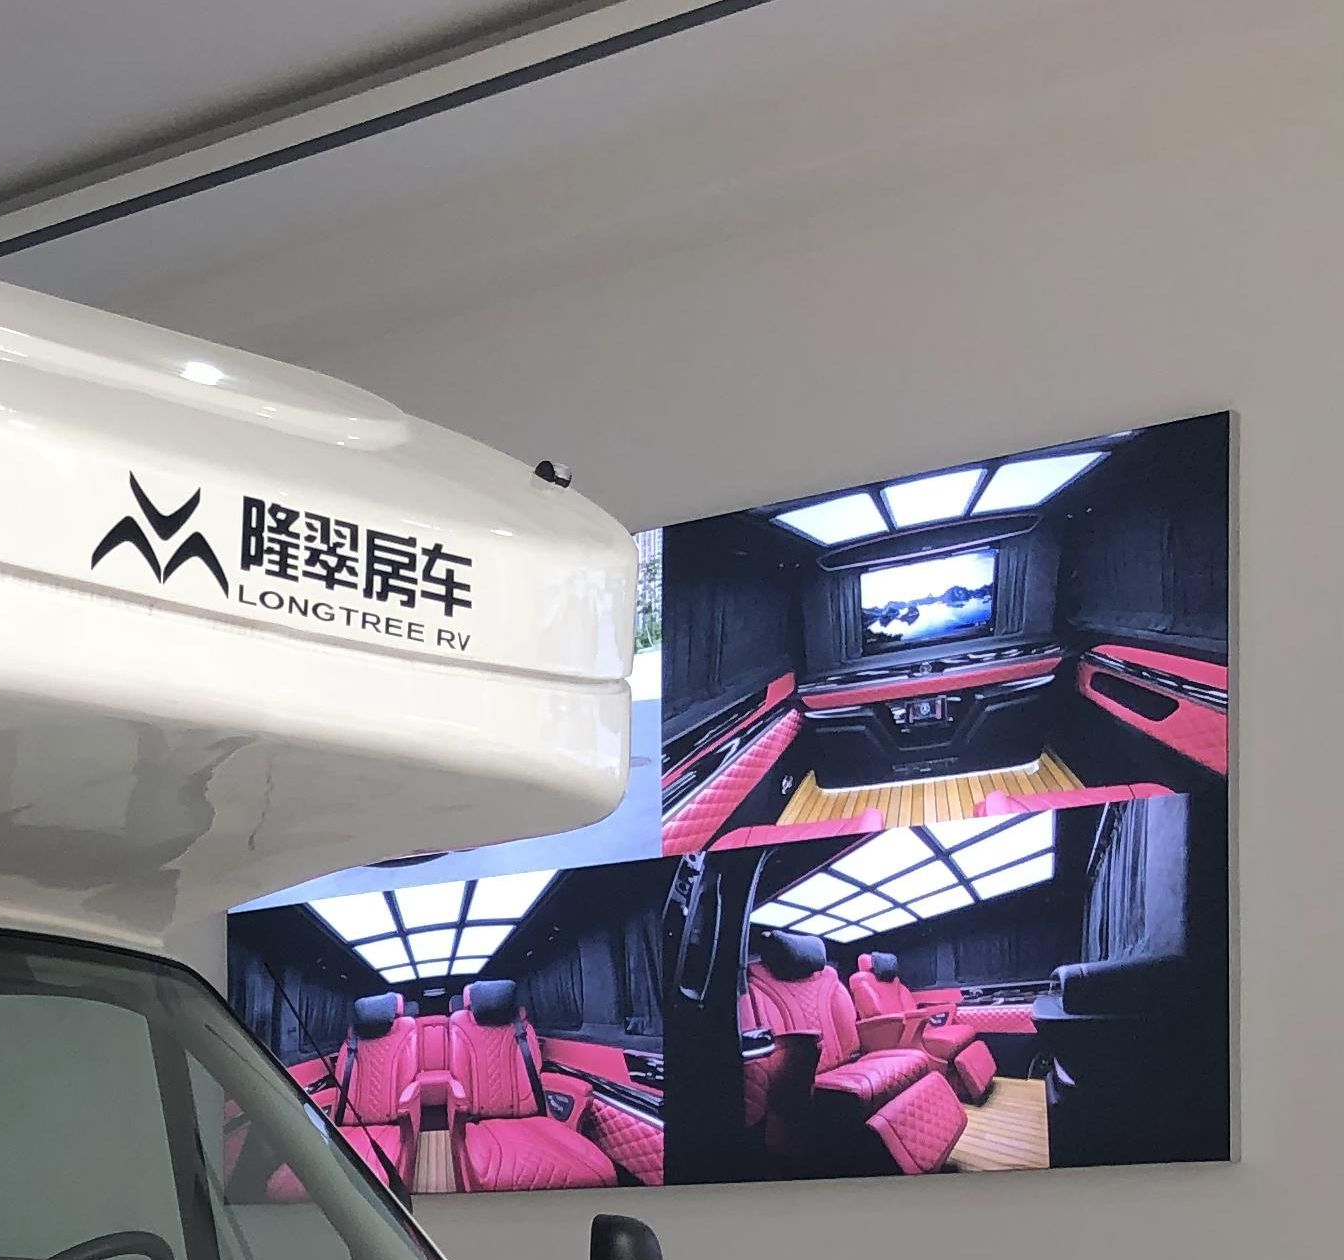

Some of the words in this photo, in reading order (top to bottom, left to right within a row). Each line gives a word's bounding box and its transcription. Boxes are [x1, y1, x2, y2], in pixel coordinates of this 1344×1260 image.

[240, 495, 473, 618] 隆翠房车
[238, 582, 425, 643] LONGTREE
[436, 628, 472, 652] RV
